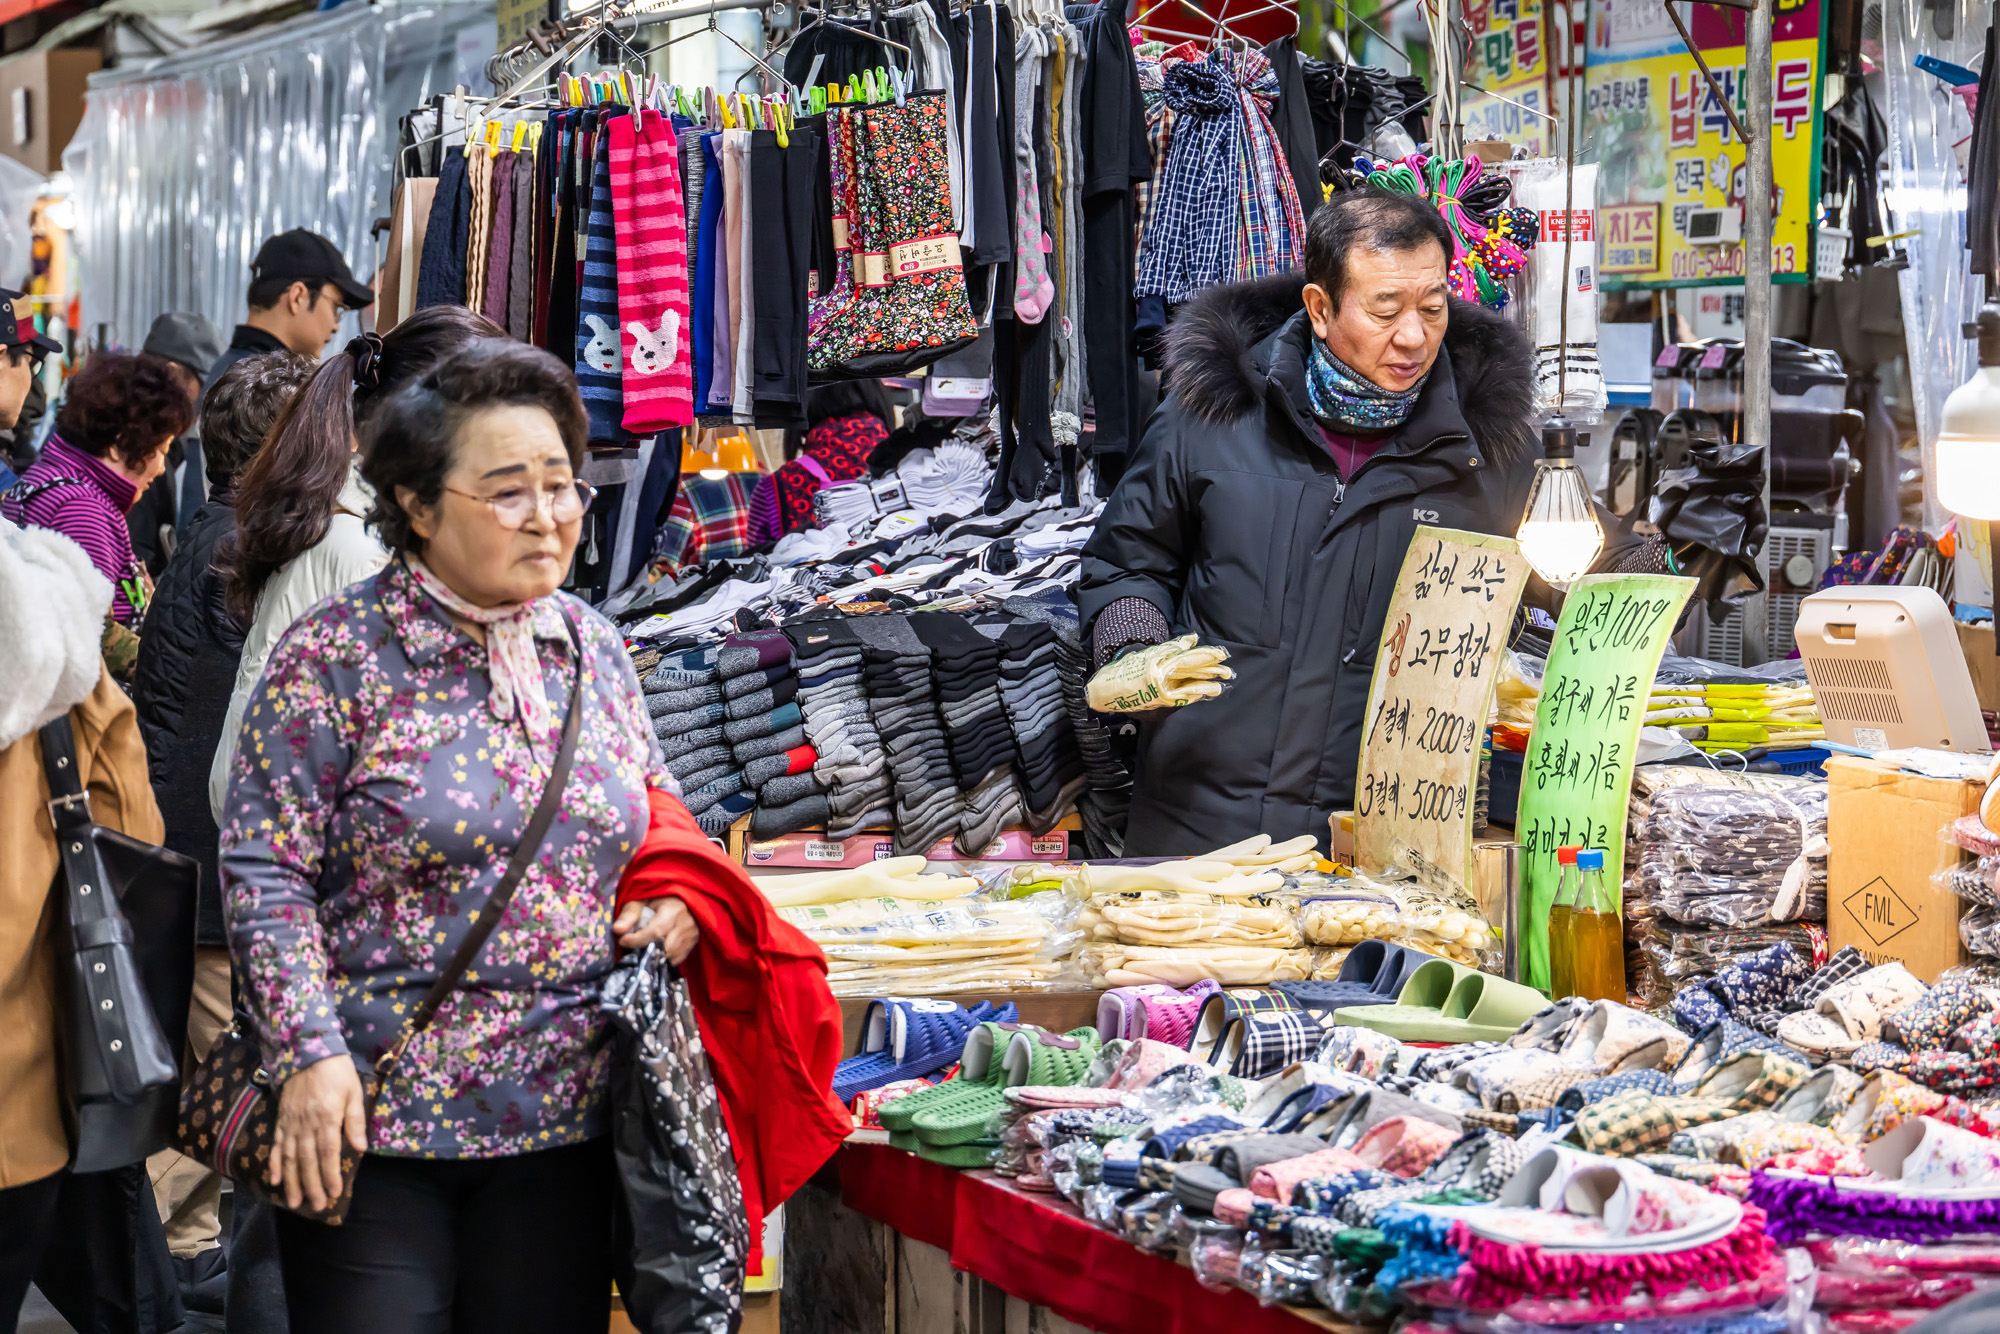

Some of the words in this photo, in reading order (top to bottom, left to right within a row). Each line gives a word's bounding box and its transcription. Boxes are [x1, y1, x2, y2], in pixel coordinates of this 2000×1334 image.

[1485, 19, 1539, 78] 만두
[1670, 62, 1808, 142] 납작두
[1674, 159, 1705, 194] 전국
[1608, 211, 1653, 243] 치즈
[1412, 508, 1440, 524] K2
[1415, 540, 1459, 600] 삶아
[1461, 555, 1506, 602] 쓰는
[1407, 622, 1491, 678] 고무장갑
[1598, 674, 1637, 732] 기름
[1583, 741, 1621, 800] 기름
[1865, 892, 1895, 927] FML
